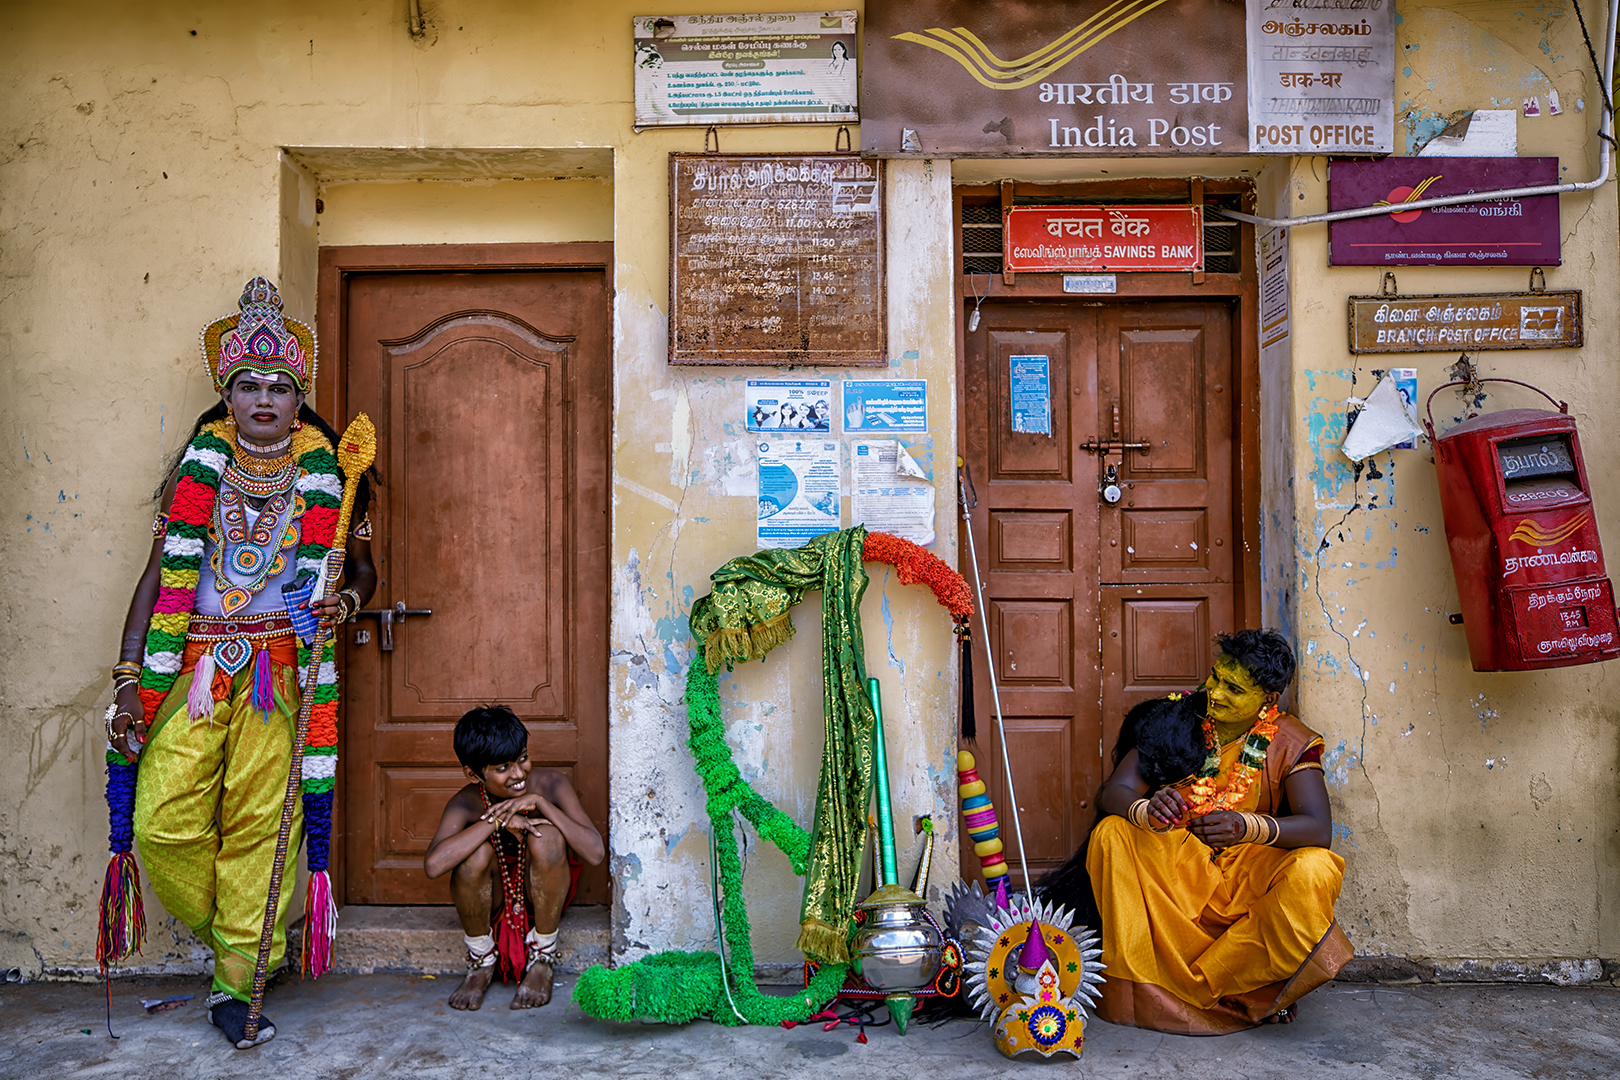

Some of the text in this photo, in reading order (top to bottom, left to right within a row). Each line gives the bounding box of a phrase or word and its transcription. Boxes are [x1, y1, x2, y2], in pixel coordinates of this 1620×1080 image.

[688, 13, 796, 25] இந்திய அஞ்சல் துறை
[1261, 17, 1372, 37] அஞ்சலகம்
[681, 42, 711, 51] செல்வ
[738, 40, 771, 50] சேமிப்பு
[773, 40, 808, 49] கணக்கு
[1279, 72, 1342, 88] डाक-घर
[1038, 74, 1234, 105] भारतीय डाक
[1048, 117, 1222, 147] India Post
[1256, 125, 1374, 145] POST OFFICE
[691, 168, 742, 191] தபால்
[777, 199, 819, 210] 628206
[1480, 203, 1522, 216] வங்கி
[785, 218, 811, 228] 11.00
[825, 219, 853, 229] 14.00
[1046, 211, 1150, 238] बचत बैंक
[812, 238, 835, 247] 11.30
[812, 254, 834, 262] 11.45
[1104, 245, 1194, 258] SAVINGS BANK
[1443, 250, 1467, 259] கிளை
[1468, 250, 1508, 260] அஞ்சலகம்
[812, 271, 835, 280] 13.45
[812, 286, 836, 294] 14.00
[1374, 302, 1501, 324] கிளை அஞ்சலகம்
[1376, 327, 1518, 344] BRANCH POST OFFICE
[1503, 446, 1559, 476] தபால்
[1508, 490, 1569, 502] 628206
